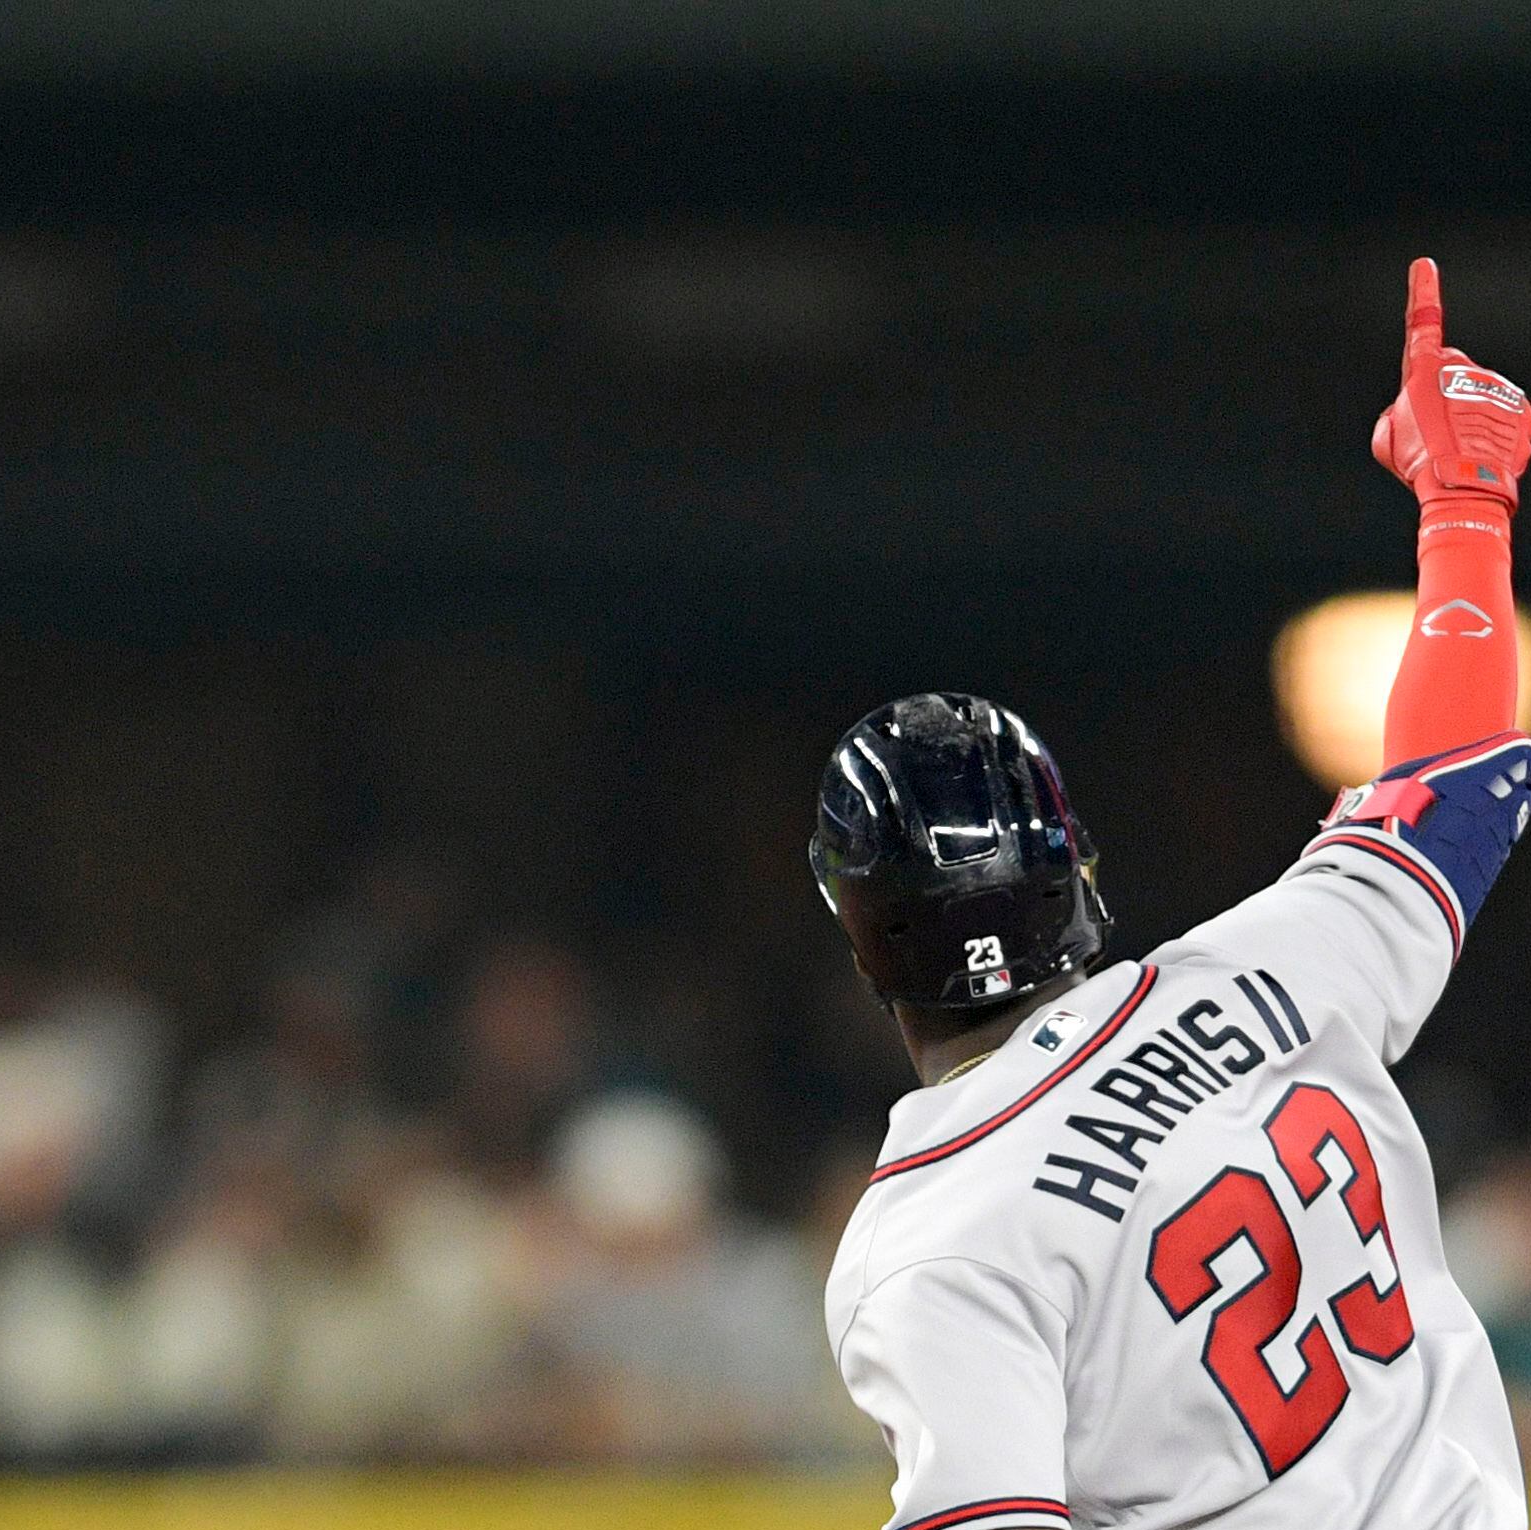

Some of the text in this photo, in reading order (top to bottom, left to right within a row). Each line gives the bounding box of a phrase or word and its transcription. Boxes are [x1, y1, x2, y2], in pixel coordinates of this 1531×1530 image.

[964, 936, 1004, 971] 23
[1032, 999, 1266, 1223] HARRIS
[1145, 1081, 1415, 1481] 23
